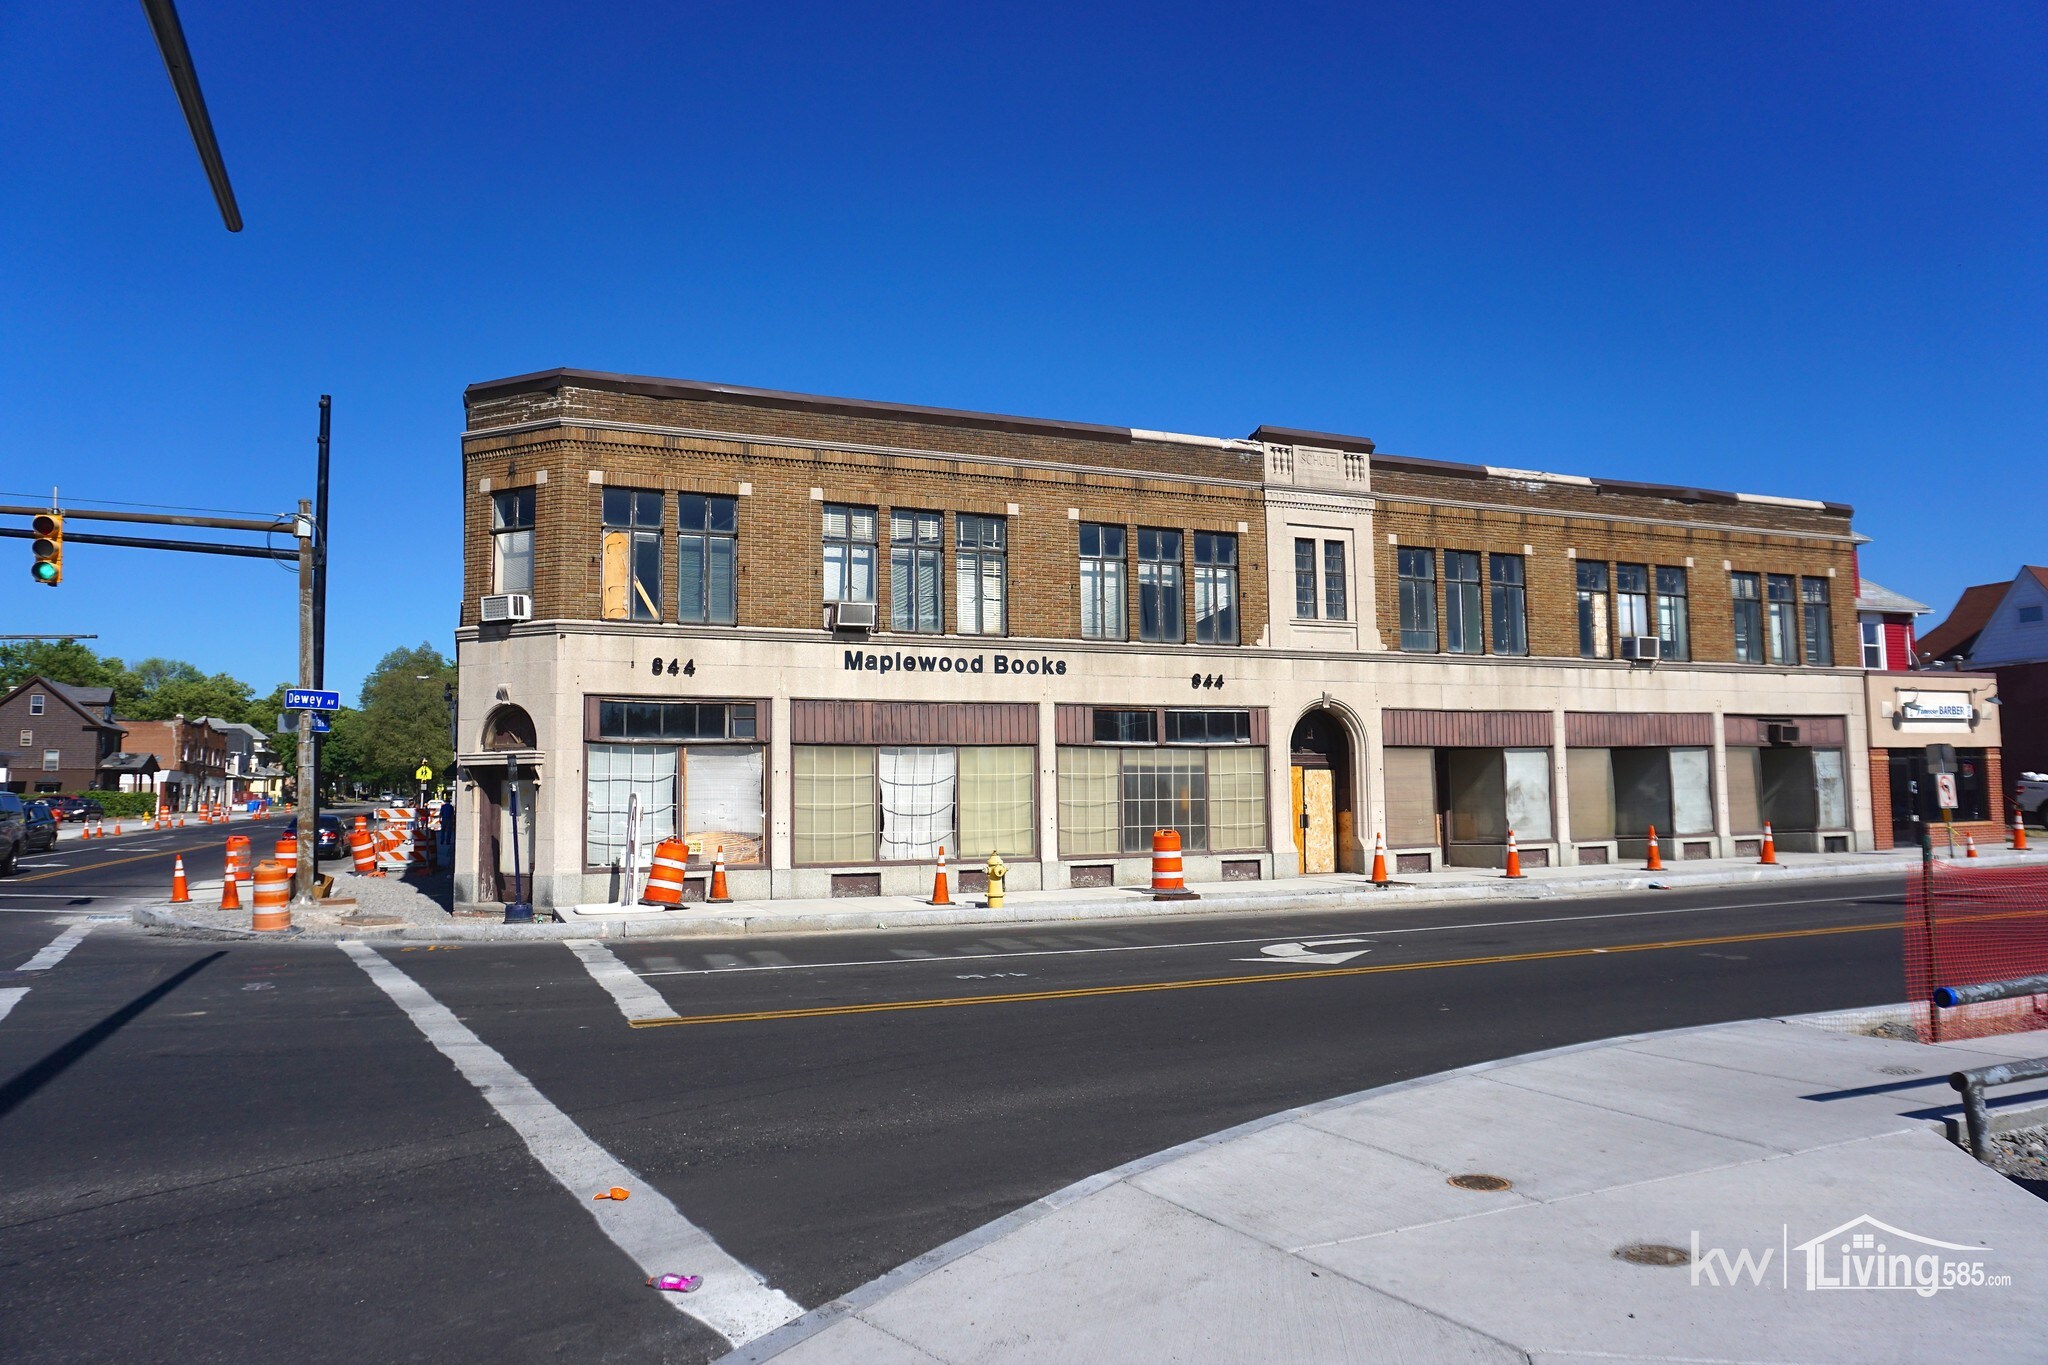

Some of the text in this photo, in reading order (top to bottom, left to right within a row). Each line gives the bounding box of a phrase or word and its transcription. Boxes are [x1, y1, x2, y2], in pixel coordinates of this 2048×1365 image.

[652, 657, 696, 677] 844
[844, 650, 1067, 676] Maplewood Books
[1192, 673, 1224, 690] 844
[289, 693, 322, 707] Dewey
[1939, 706, 1964, 715] BARBER
